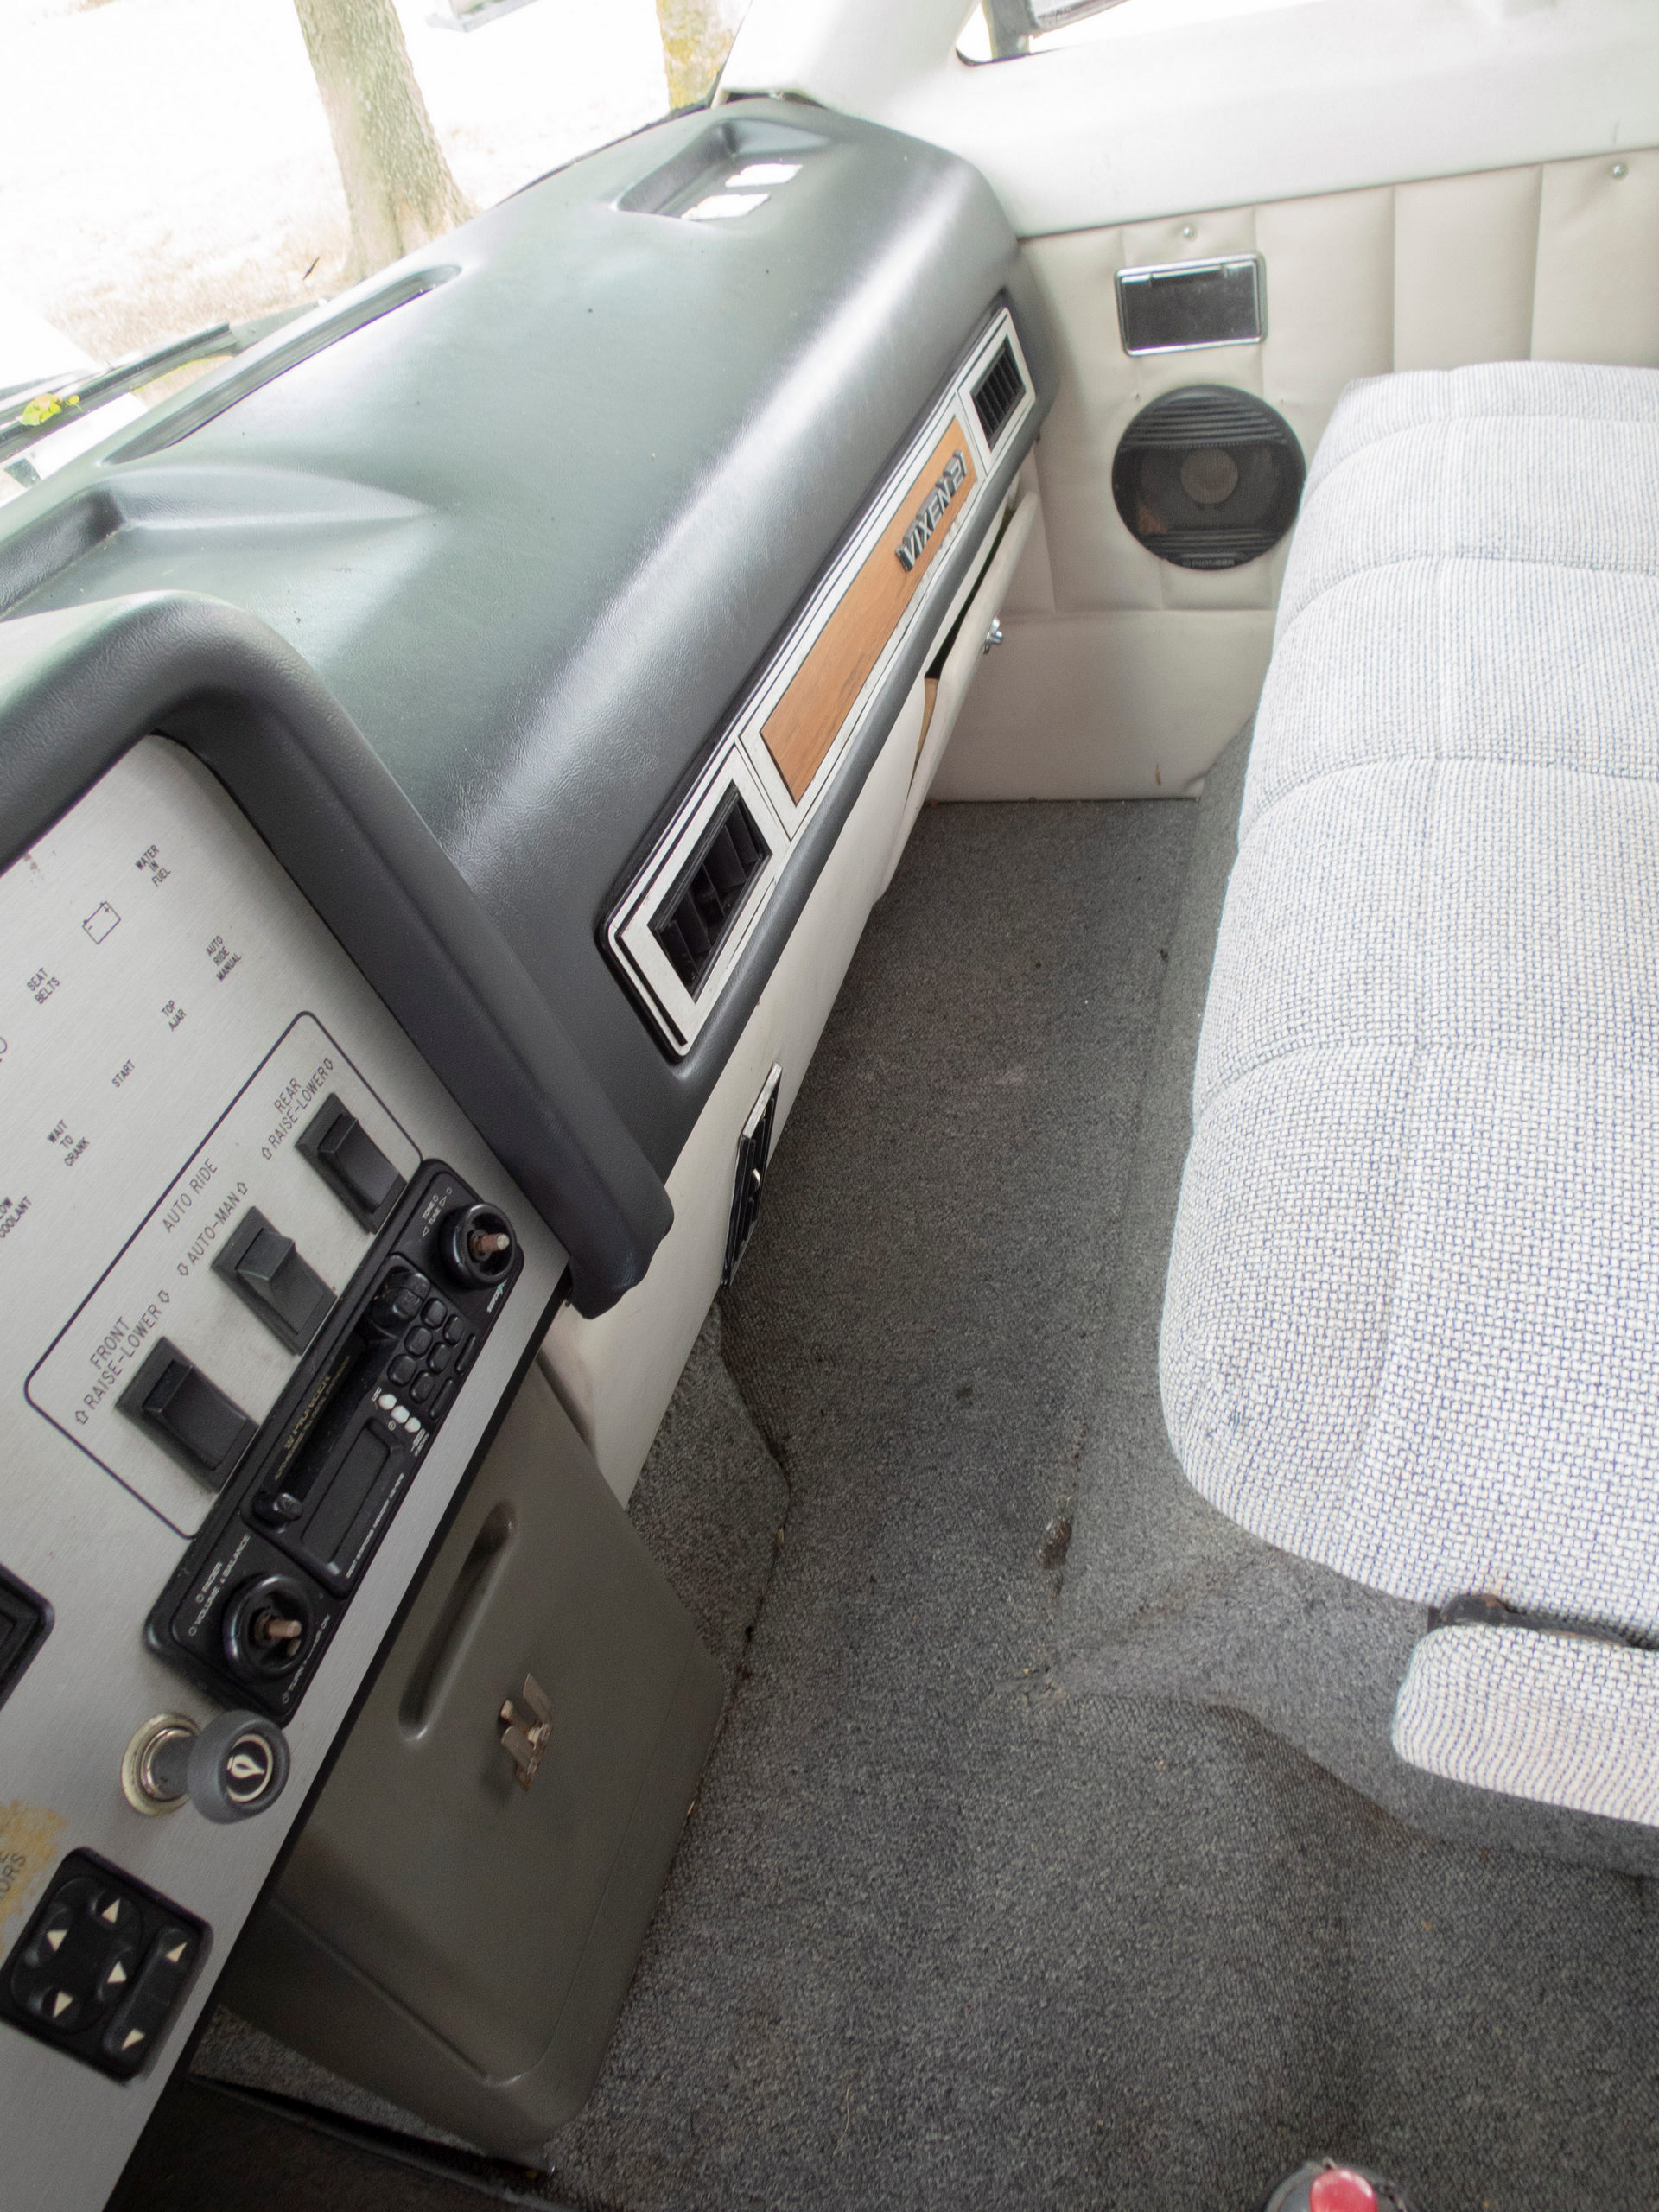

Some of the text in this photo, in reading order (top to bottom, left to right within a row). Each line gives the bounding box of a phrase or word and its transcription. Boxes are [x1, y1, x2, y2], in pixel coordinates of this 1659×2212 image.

[897, 479, 951, 571] VIXEN
[135, 844, 159, 871] WATER
[149, 861, 159, 873] IN
[151, 868, 171, 887] FUEL
[206, 935, 224, 957] AUTO
[213, 947, 230, 966] RIDE
[27, 968, 49, 992] SEAT
[216, 952, 242, 982] MANUAL
[35, 977, 60, 1005] BELTS
[162, 1000, 175, 1018] TOP
[168, 1008, 187, 1032] AJAR
[111, 1059, 136, 1088] START
[269, 1066, 329, 1150] RAISE-LOWER
[274, 1077, 301, 1114] REAR
[47, 1119, 68, 1145] WAIT
[60, 1135, 73, 1150] TO
[64, 1137, 90, 1167] CRANK
[162, 1158, 217, 1233] AUTO RIDE
[0, 1196, 32, 1238] COOLANT
[188, 1192, 240, 1266] AUTO-MAN
[84, 1304, 162, 1410] RAISE-LOWER
[90, 1316, 130, 1370] FRONT
[194, 1534, 251, 1624] VOLUME BALANCE
